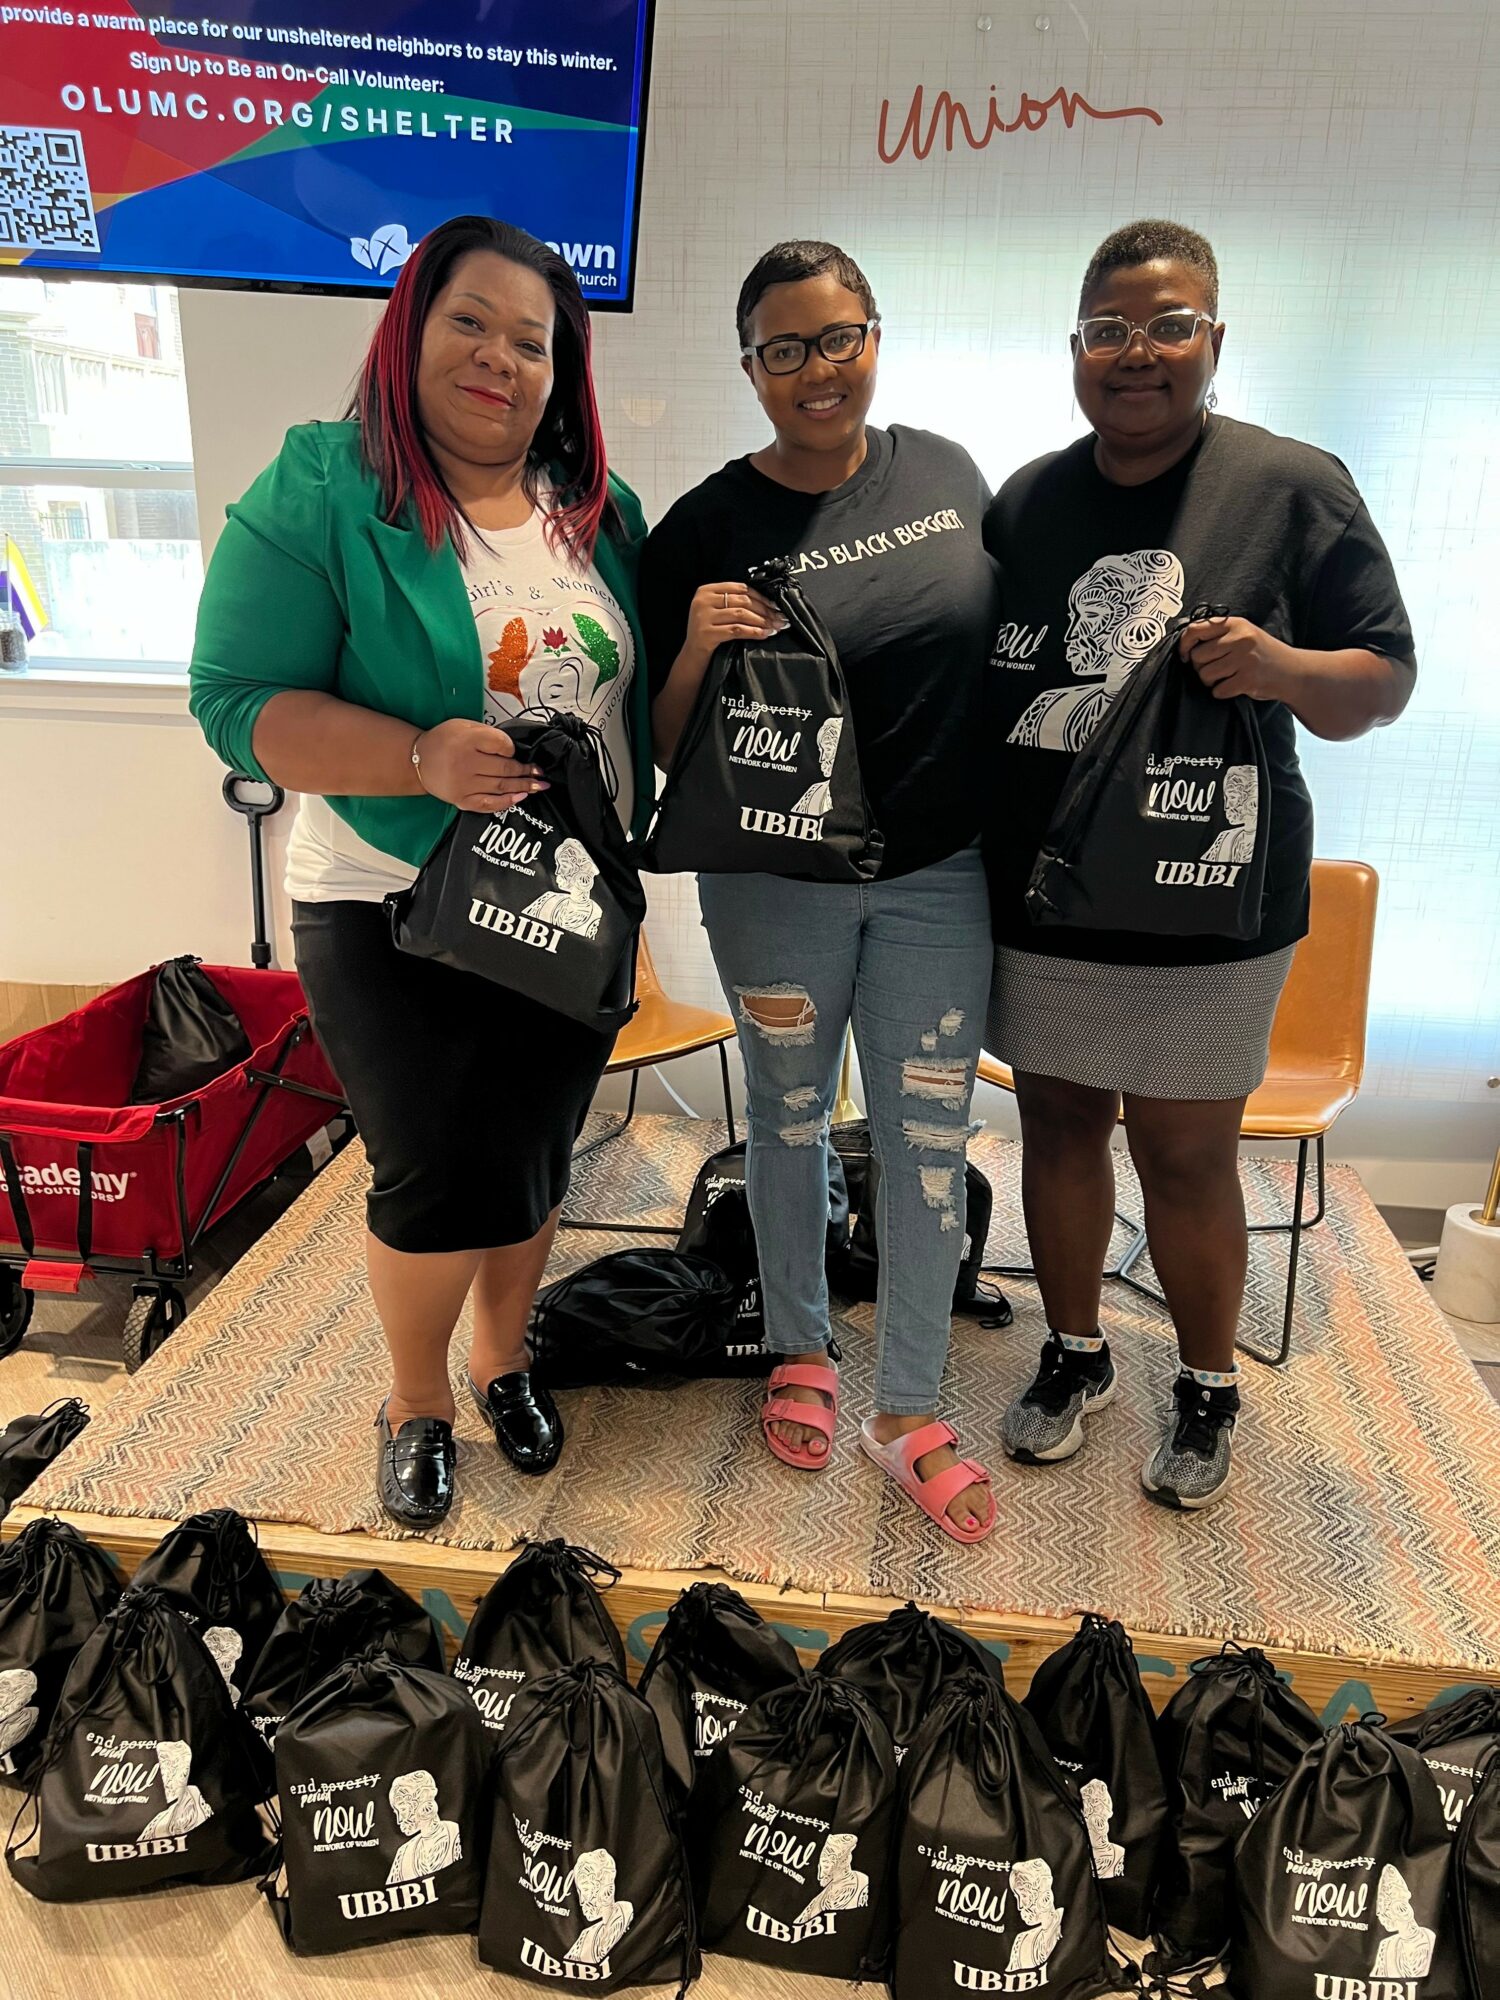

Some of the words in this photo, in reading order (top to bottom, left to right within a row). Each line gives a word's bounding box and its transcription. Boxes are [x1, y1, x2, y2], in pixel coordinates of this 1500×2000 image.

[1, 5, 73, 26] provide
[78, 14, 90, 27] a
[92, 12, 145, 31] warm
[149, 16, 199, 36] place
[202, 19, 228, 38] for
[232, 24, 263, 41] our
[266, 27, 372, 51] unsheltered
[376, 35, 462, 58] neighbors
[466, 43, 484, 60] to
[487, 45, 523, 66] stay
[526, 48, 557, 66] this
[561, 51, 618, 71] winter.
[129, 51, 172, 75] Sign
[174, 54, 201, 77] Up
[204, 58, 224, 76] to
[228, 59, 251, 77] Be
[255, 65, 278, 80] an
[281, 63, 349, 86] On-Call
[352, 69, 445, 93] Volunteer:
[61, 84, 514, 144] OLUMC.ORG/SHELTER
[574, 271, 617, 287] hurch
[828, 531, 896, 565] BLACK
[893, 508, 965, 546] BLOGGER
[529, 586, 544, 600] &
[728, 755, 762, 768] NETWORK
[762, 761, 771, 769] OF
[771, 762, 798, 774] WOMEN
[471, 844, 500, 866] NETWORK
[500, 859, 510, 868] OF
[509, 862, 536, 877] WOMEN
[1154, 860, 1242, 888] UBIBI
[468, 898, 565, 954] UBIBI
[84, 1793, 120, 1805] NETWORK
[86, 1835, 189, 1863] UBIBI
[313, 1841, 346, 1852] NETWORK
[346, 1840, 355, 1848] OF
[355, 1838, 379, 1848] WOMEN
[772, 1861, 782, 1871] OF
[782, 1865, 806, 1885] WOMEN
[955, 1853, 1011, 1872] povert
[338, 1876, 439, 1920] UBIBI
[745, 1904, 837, 1945] UBIBI
[935, 1906, 969, 1924] NETWORK
[969, 1918, 980, 1927] OF
[1291, 1915, 1328, 1926] NETWORK
[1328, 1918, 1339, 1927] OF
[1339, 1919, 1369, 1931] WOMEN
[519, 1937, 613, 1982] UBIBI
[953, 1960, 1049, 1992] UBIBI
[1314, 1973, 1419, 2000] UBIBI
